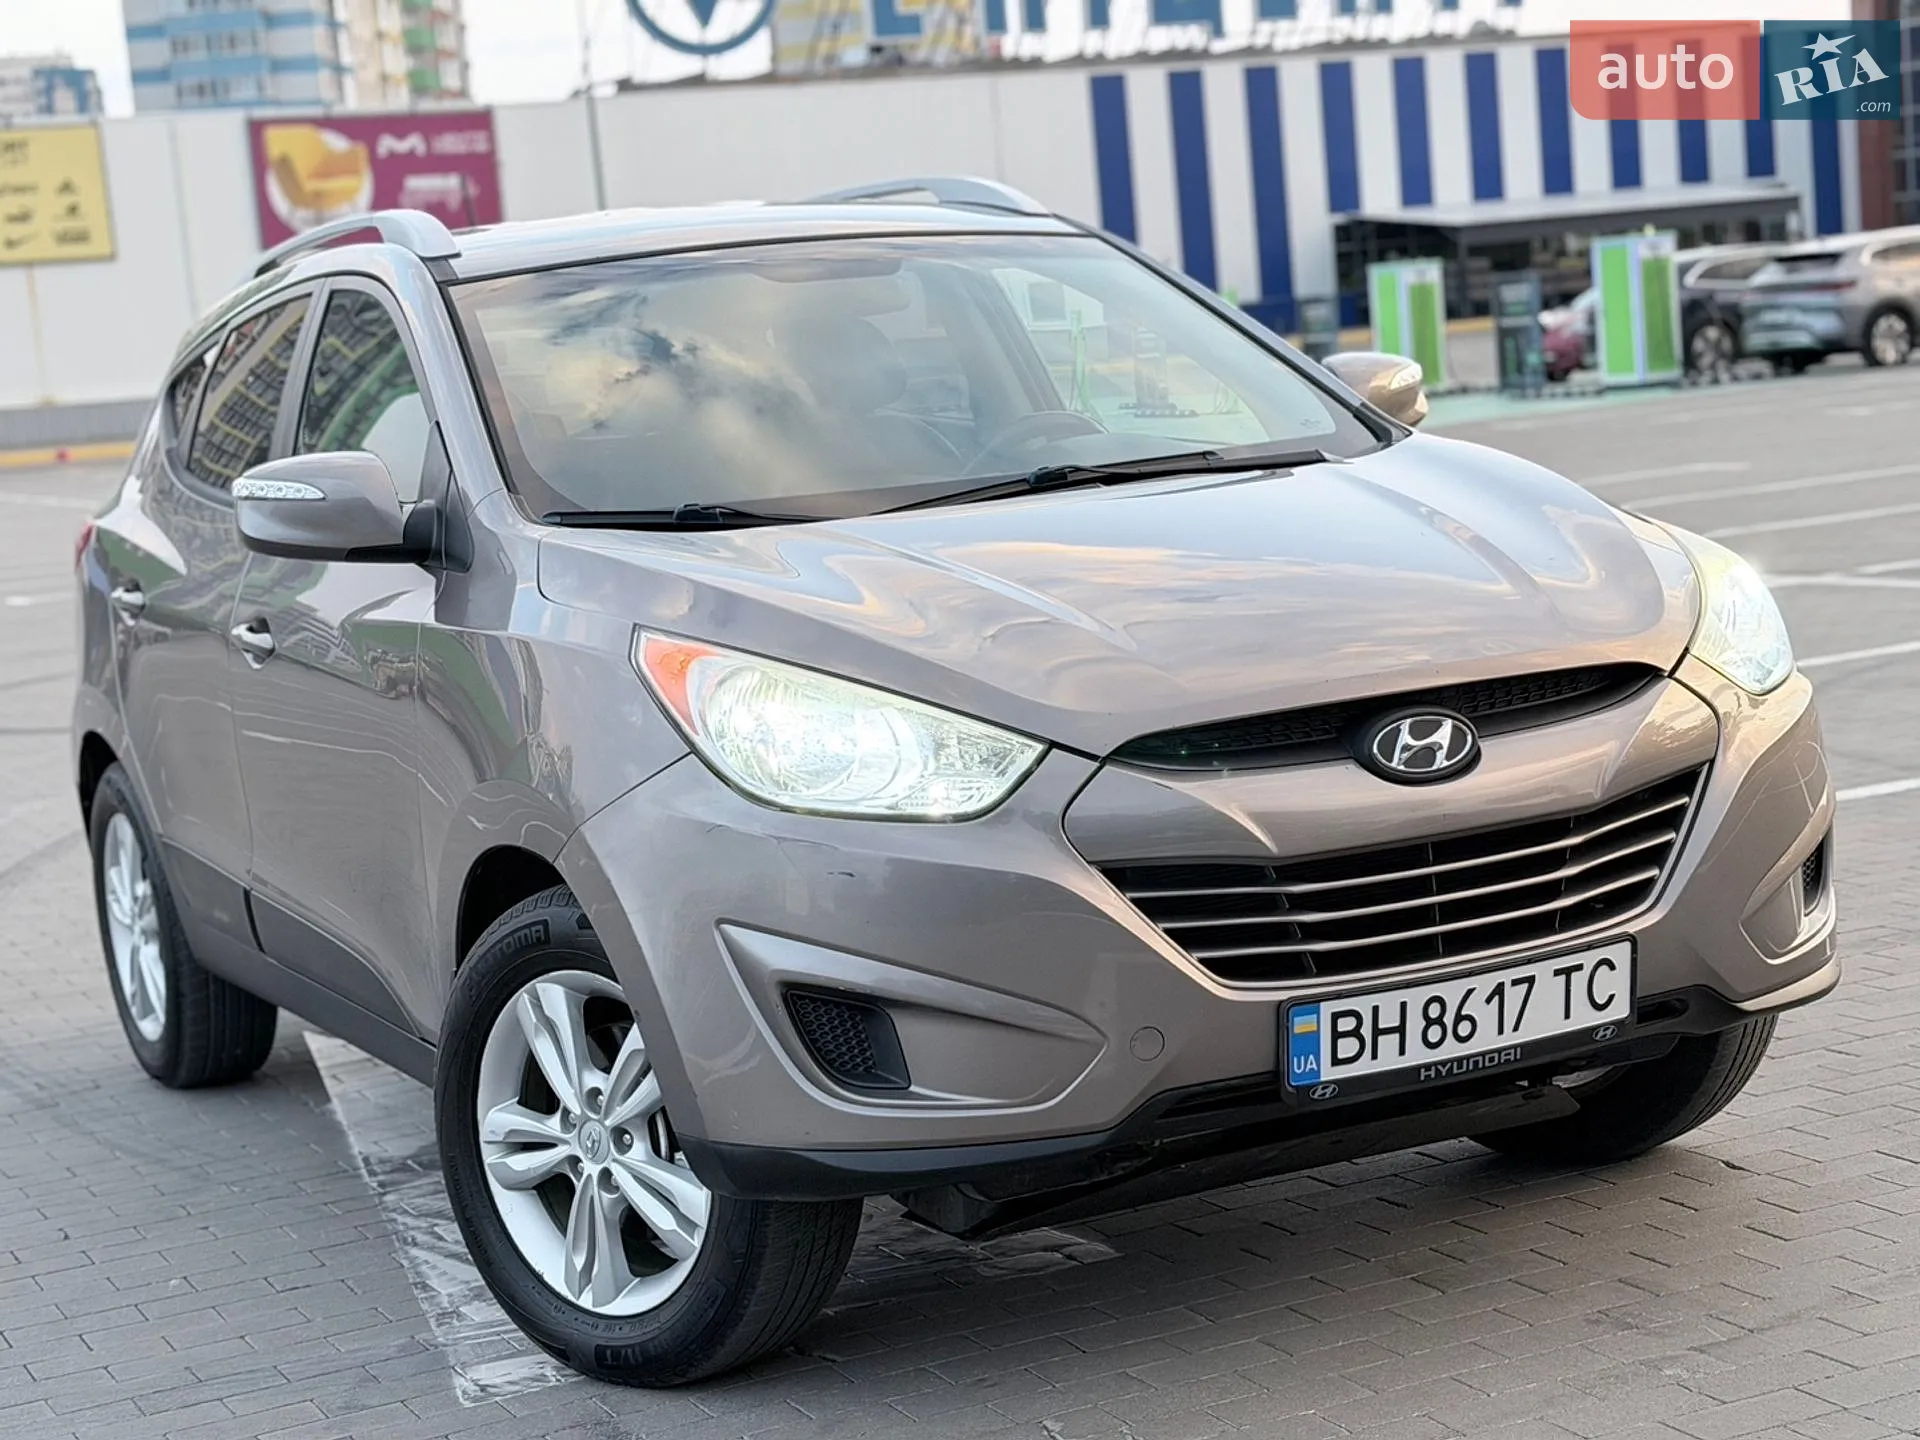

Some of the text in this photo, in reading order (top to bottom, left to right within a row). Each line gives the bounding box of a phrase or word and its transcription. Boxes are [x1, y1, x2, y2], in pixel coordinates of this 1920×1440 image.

[1330, 957, 1618, 1068] BH 8617 TC
[1293, 1054, 1319, 1074] UA
[1419, 1046, 1523, 1082] HYUNDAI
